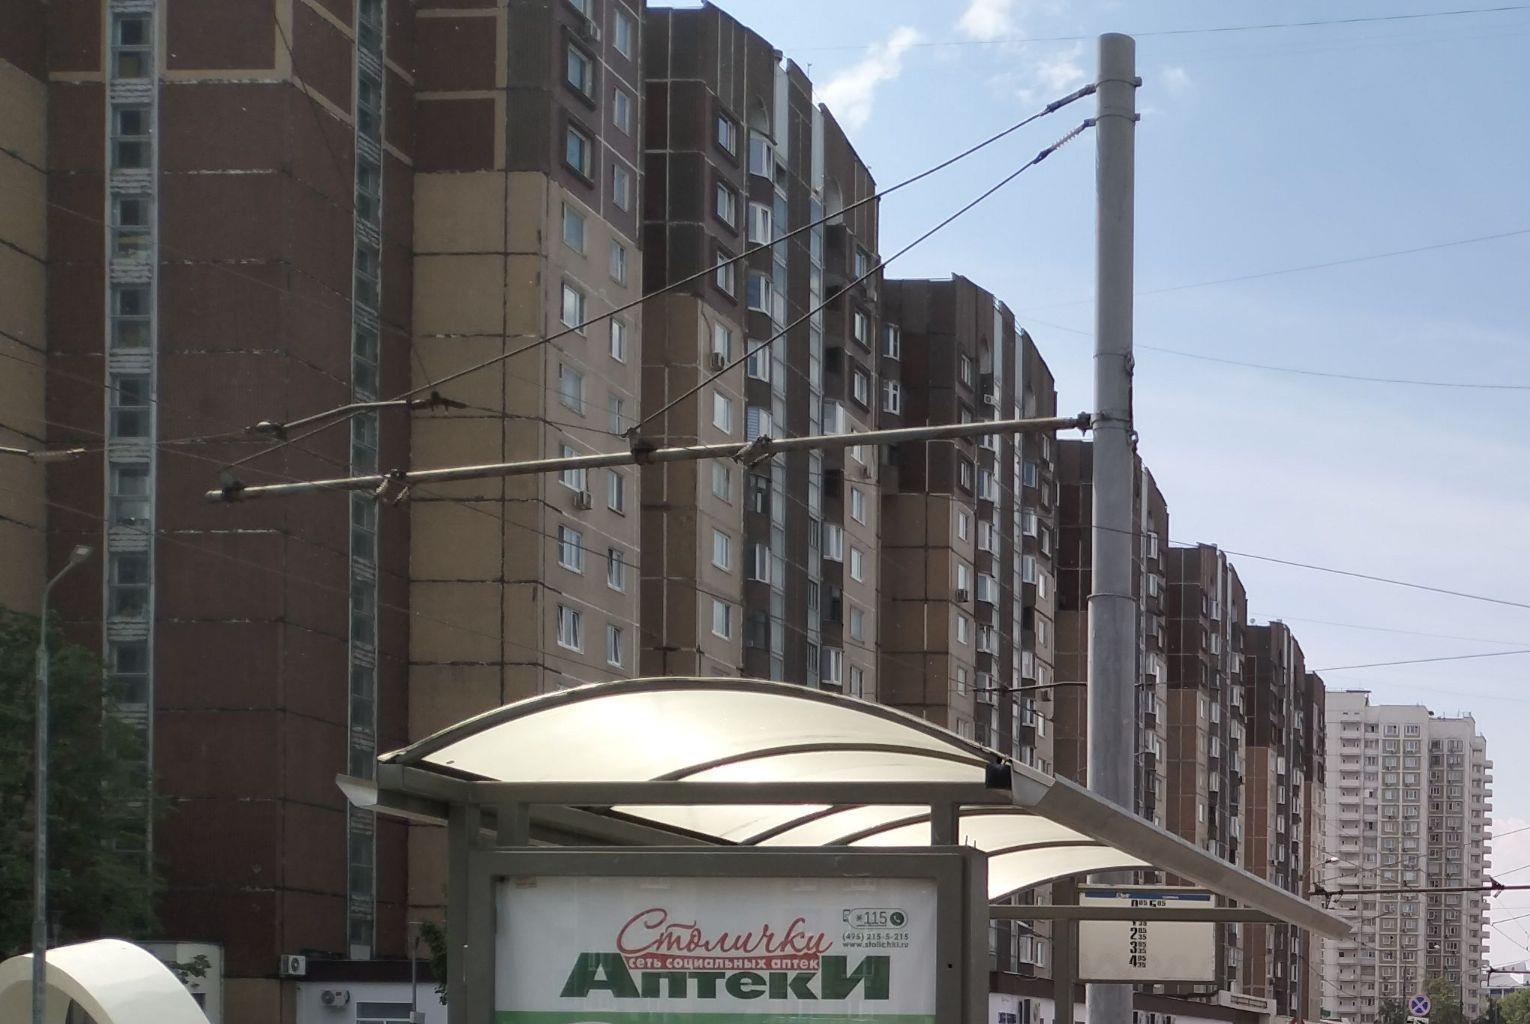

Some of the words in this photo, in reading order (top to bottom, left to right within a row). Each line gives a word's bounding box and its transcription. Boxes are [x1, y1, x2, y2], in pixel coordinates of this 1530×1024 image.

[616, 908, 833, 956] Столички
[1130, 927, 1138, 940] 2
[1130, 941, 1137, 954] 3
[628, 957, 664, 970] сеть
[665, 957, 767, 970] социальных
[770, 956, 819, 970] аптек
[1129, 955, 1137, 967] 4
